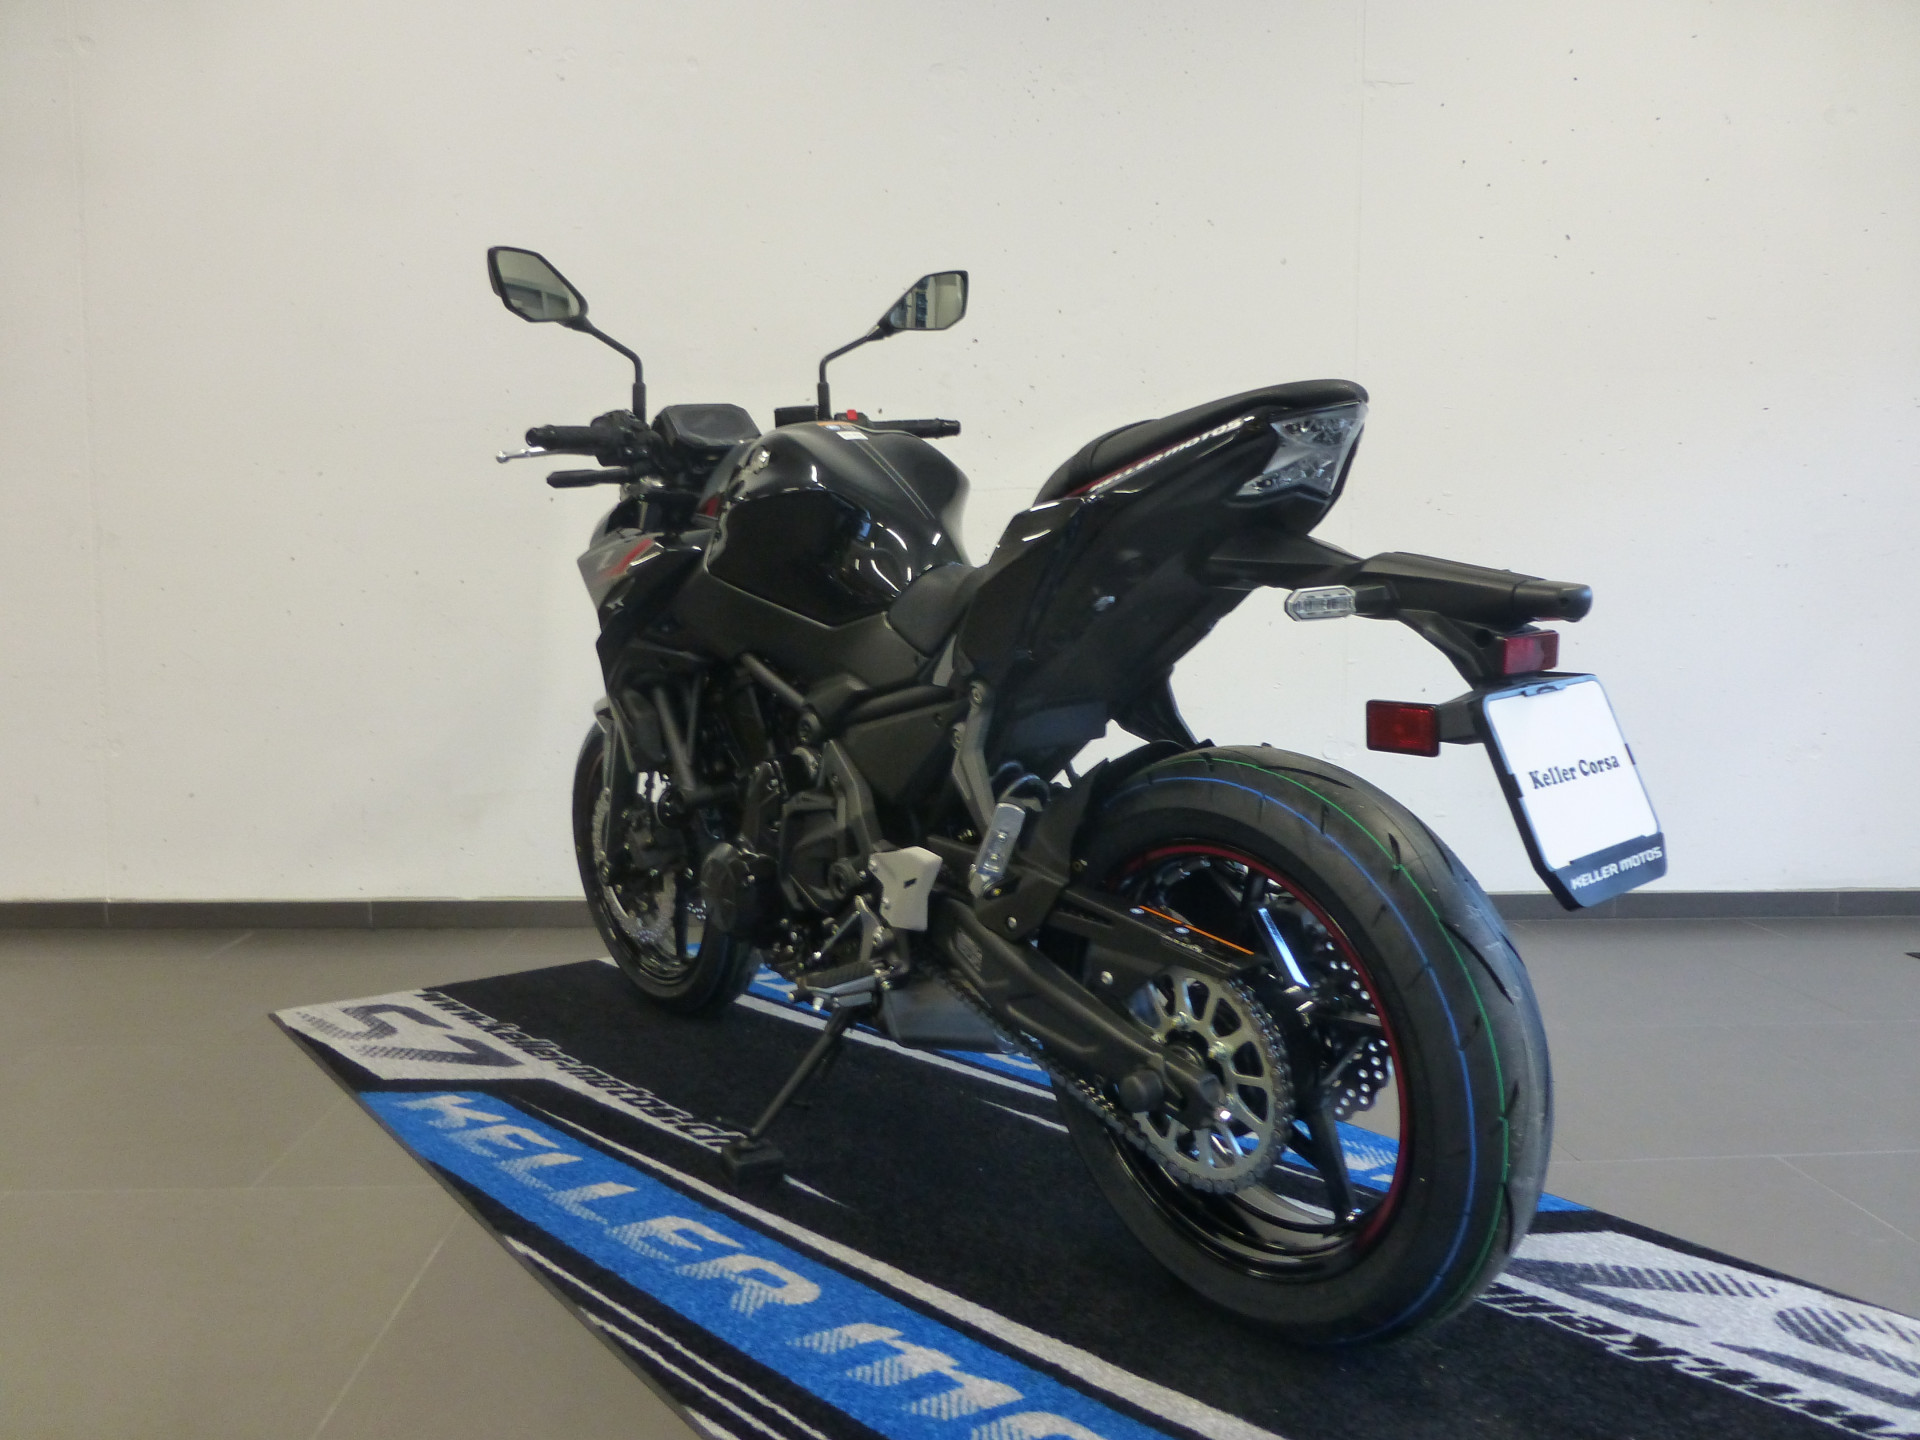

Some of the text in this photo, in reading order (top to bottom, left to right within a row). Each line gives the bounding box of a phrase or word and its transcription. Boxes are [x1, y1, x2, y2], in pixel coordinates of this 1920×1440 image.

[1529, 755, 1620, 790] Keller Corsa
[1570, 863, 1619, 890] KELLER
[394, 1094, 821, 1318] KELLER
